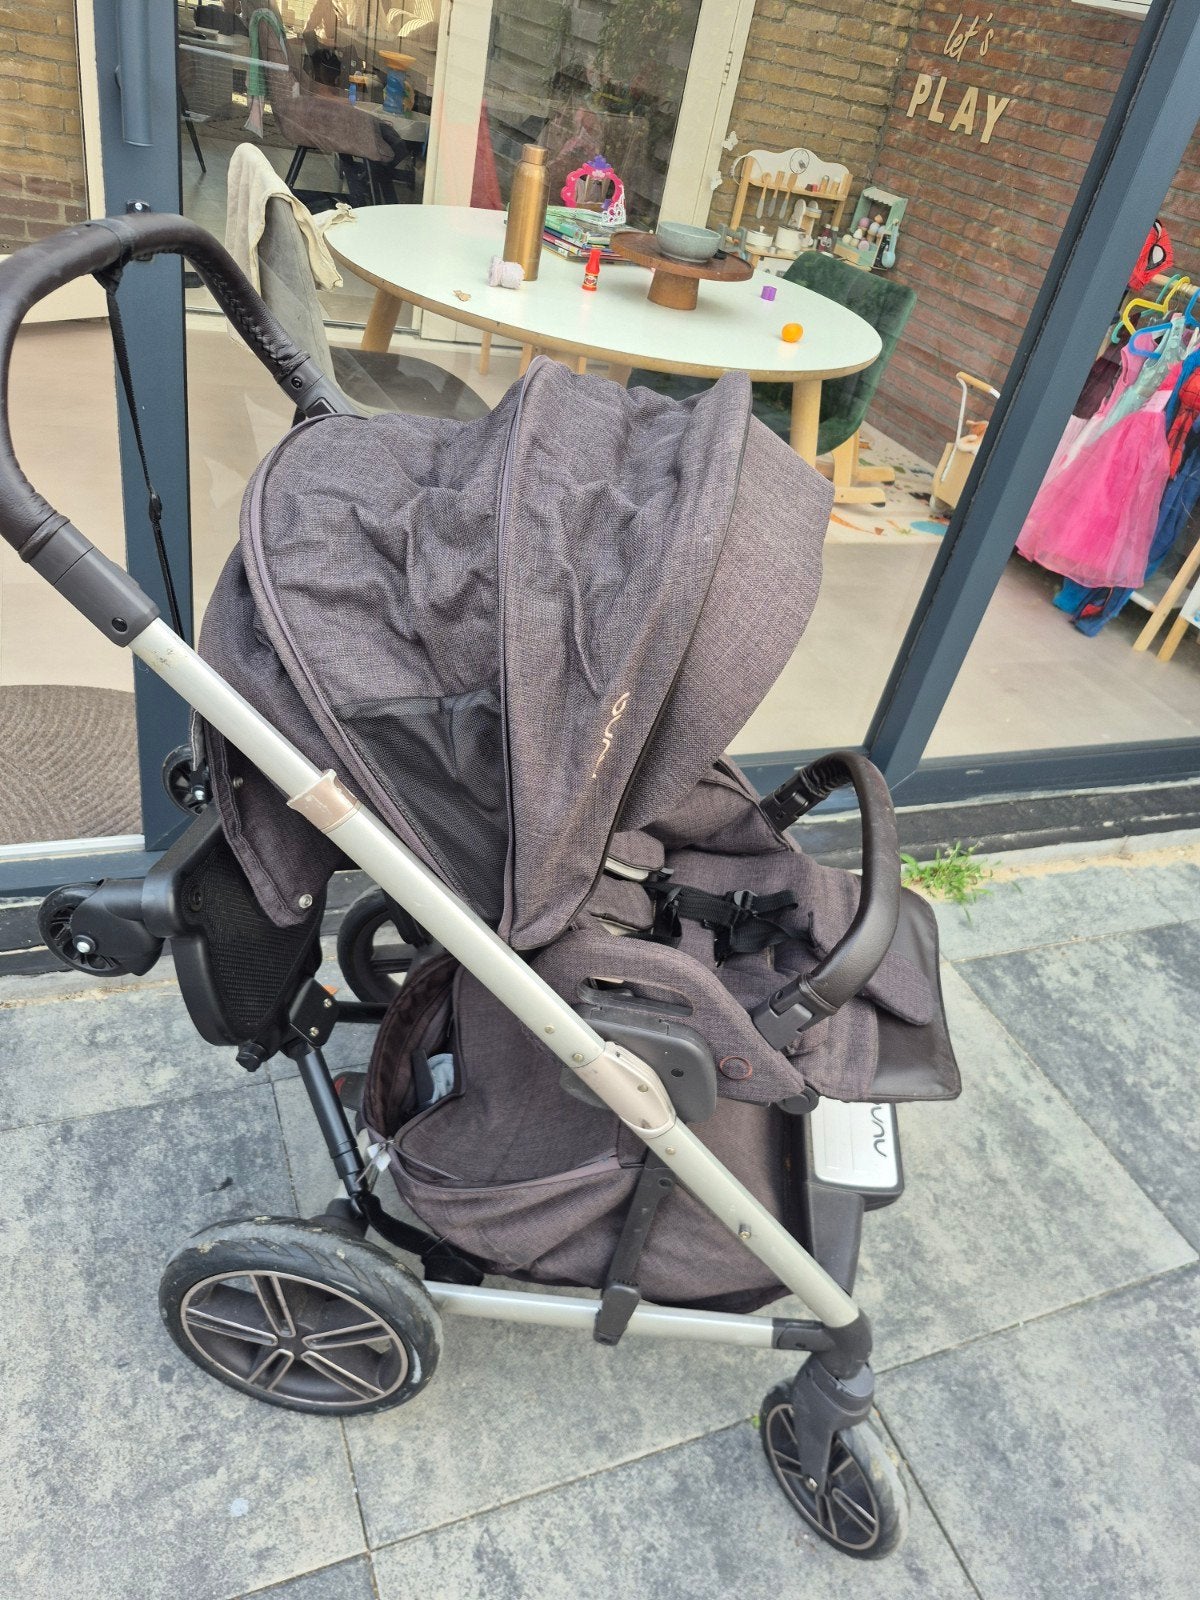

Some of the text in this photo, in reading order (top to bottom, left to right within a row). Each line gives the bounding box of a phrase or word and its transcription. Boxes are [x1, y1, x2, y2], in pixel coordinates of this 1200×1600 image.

[943, 12, 994, 62] let's
[906, 73, 1011, 144] PLAY
[870, 1103, 887, 1158] nun
